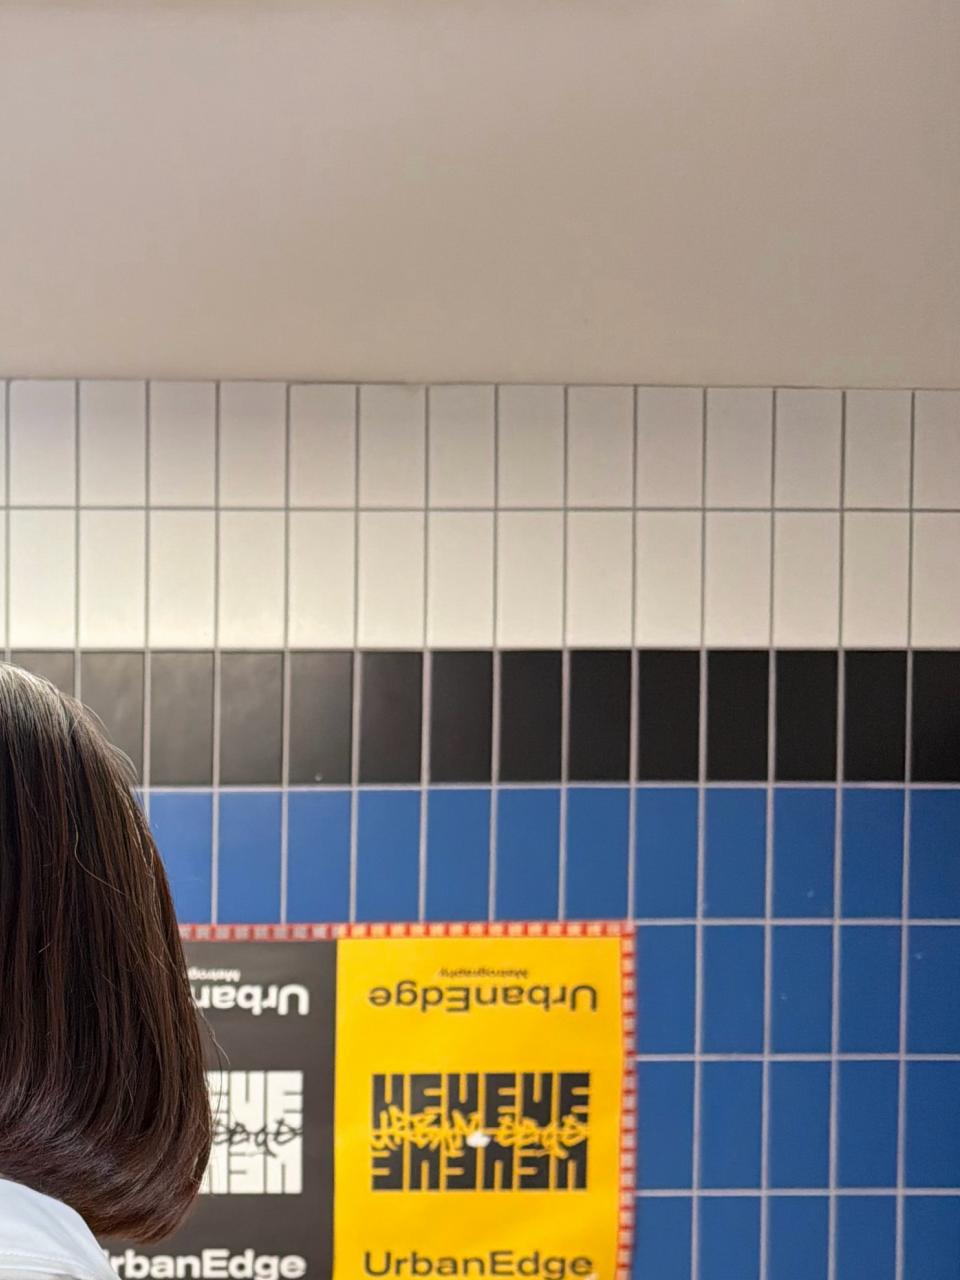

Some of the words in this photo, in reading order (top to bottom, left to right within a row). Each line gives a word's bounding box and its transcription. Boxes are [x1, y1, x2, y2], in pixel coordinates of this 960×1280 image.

[187, 968, 240, 982] Metrog
[190, 984, 309, 1016] Urban
[368, 981, 598, 1013] UrbanEdge
